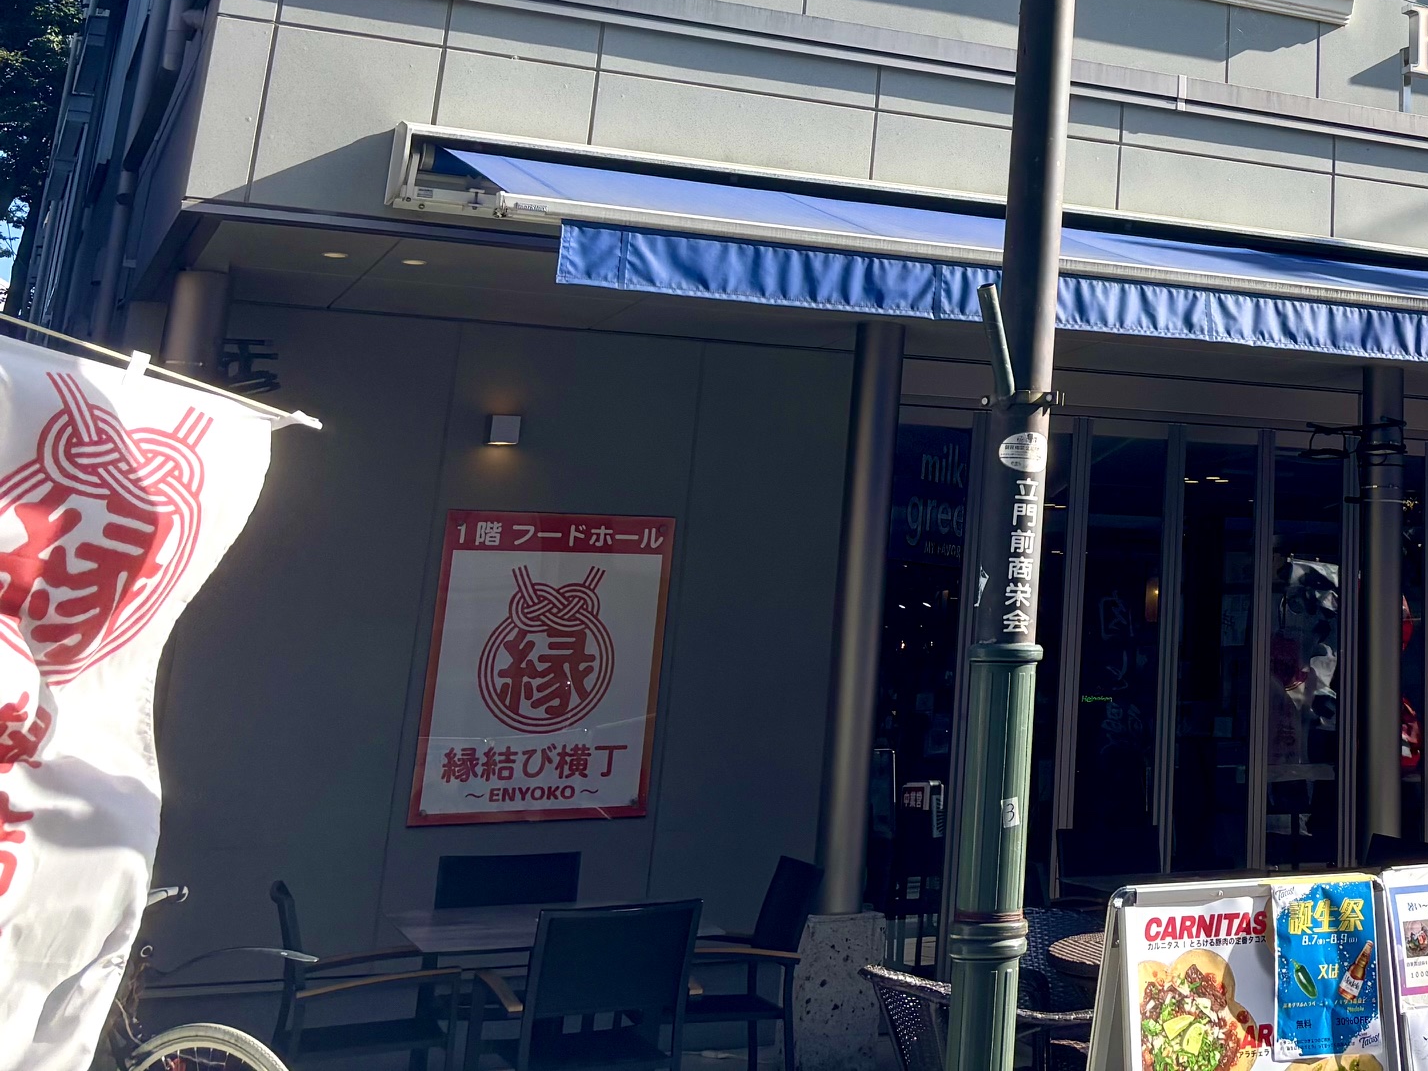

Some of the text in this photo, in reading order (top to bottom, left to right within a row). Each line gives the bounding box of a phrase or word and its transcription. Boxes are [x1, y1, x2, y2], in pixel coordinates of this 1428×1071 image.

[920, 442, 967, 489] milk
[456, 521, 665, 549] 1階 フードホール
[1001, 477, 1039, 635] 立門前商栄会
[497, 629, 597, 717] 縁
[441, 743, 628, 784] 縁結び横丁
[1006, 803, 1015, 822] 3
[1144, 910, 1268, 942] CARNITAS
[1288, 897, 1365, 935] 誕生祭
[1147, 940, 1180, 951] カルニタス
[1317, 963, 1339, 980] 又は
[1295, 1018, 1313, 1029] 無料
[1335, 1015, 1370, 1026] 30%OFF
[1358, 1033, 1380, 1049] Tacos!
